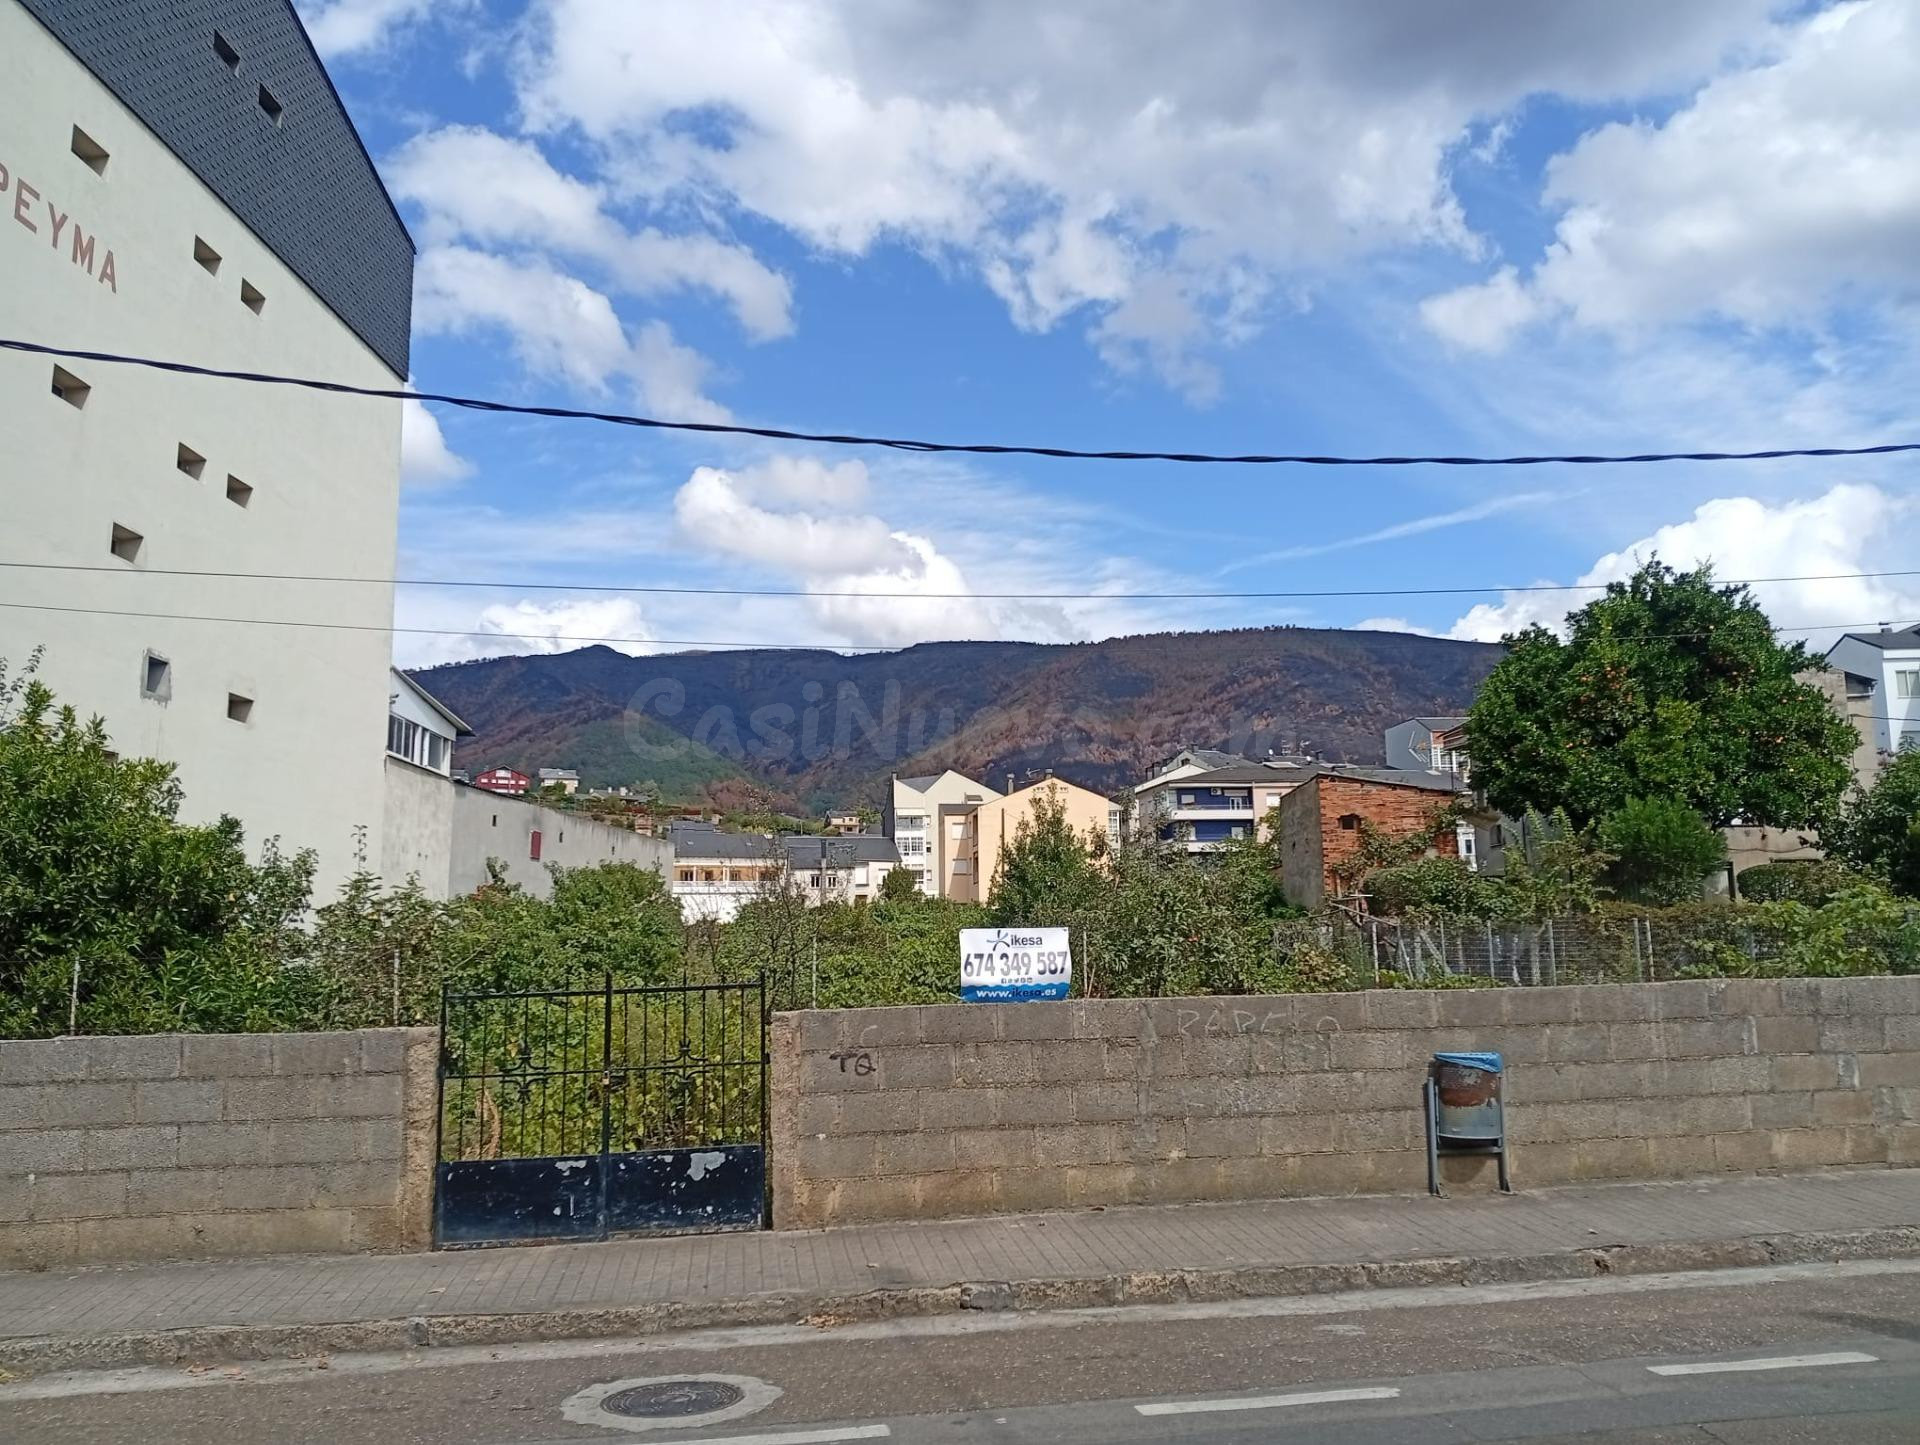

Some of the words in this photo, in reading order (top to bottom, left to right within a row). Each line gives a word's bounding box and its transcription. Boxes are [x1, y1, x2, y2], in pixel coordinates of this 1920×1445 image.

[1010, 934, 1043, 946] ikesa
[963, 953, 996, 977] 674
[1000, 952, 1032, 977] 349
[1037, 951, 1068, 975] 587
[976, 987, 1057, 998] www.ikesa.es
